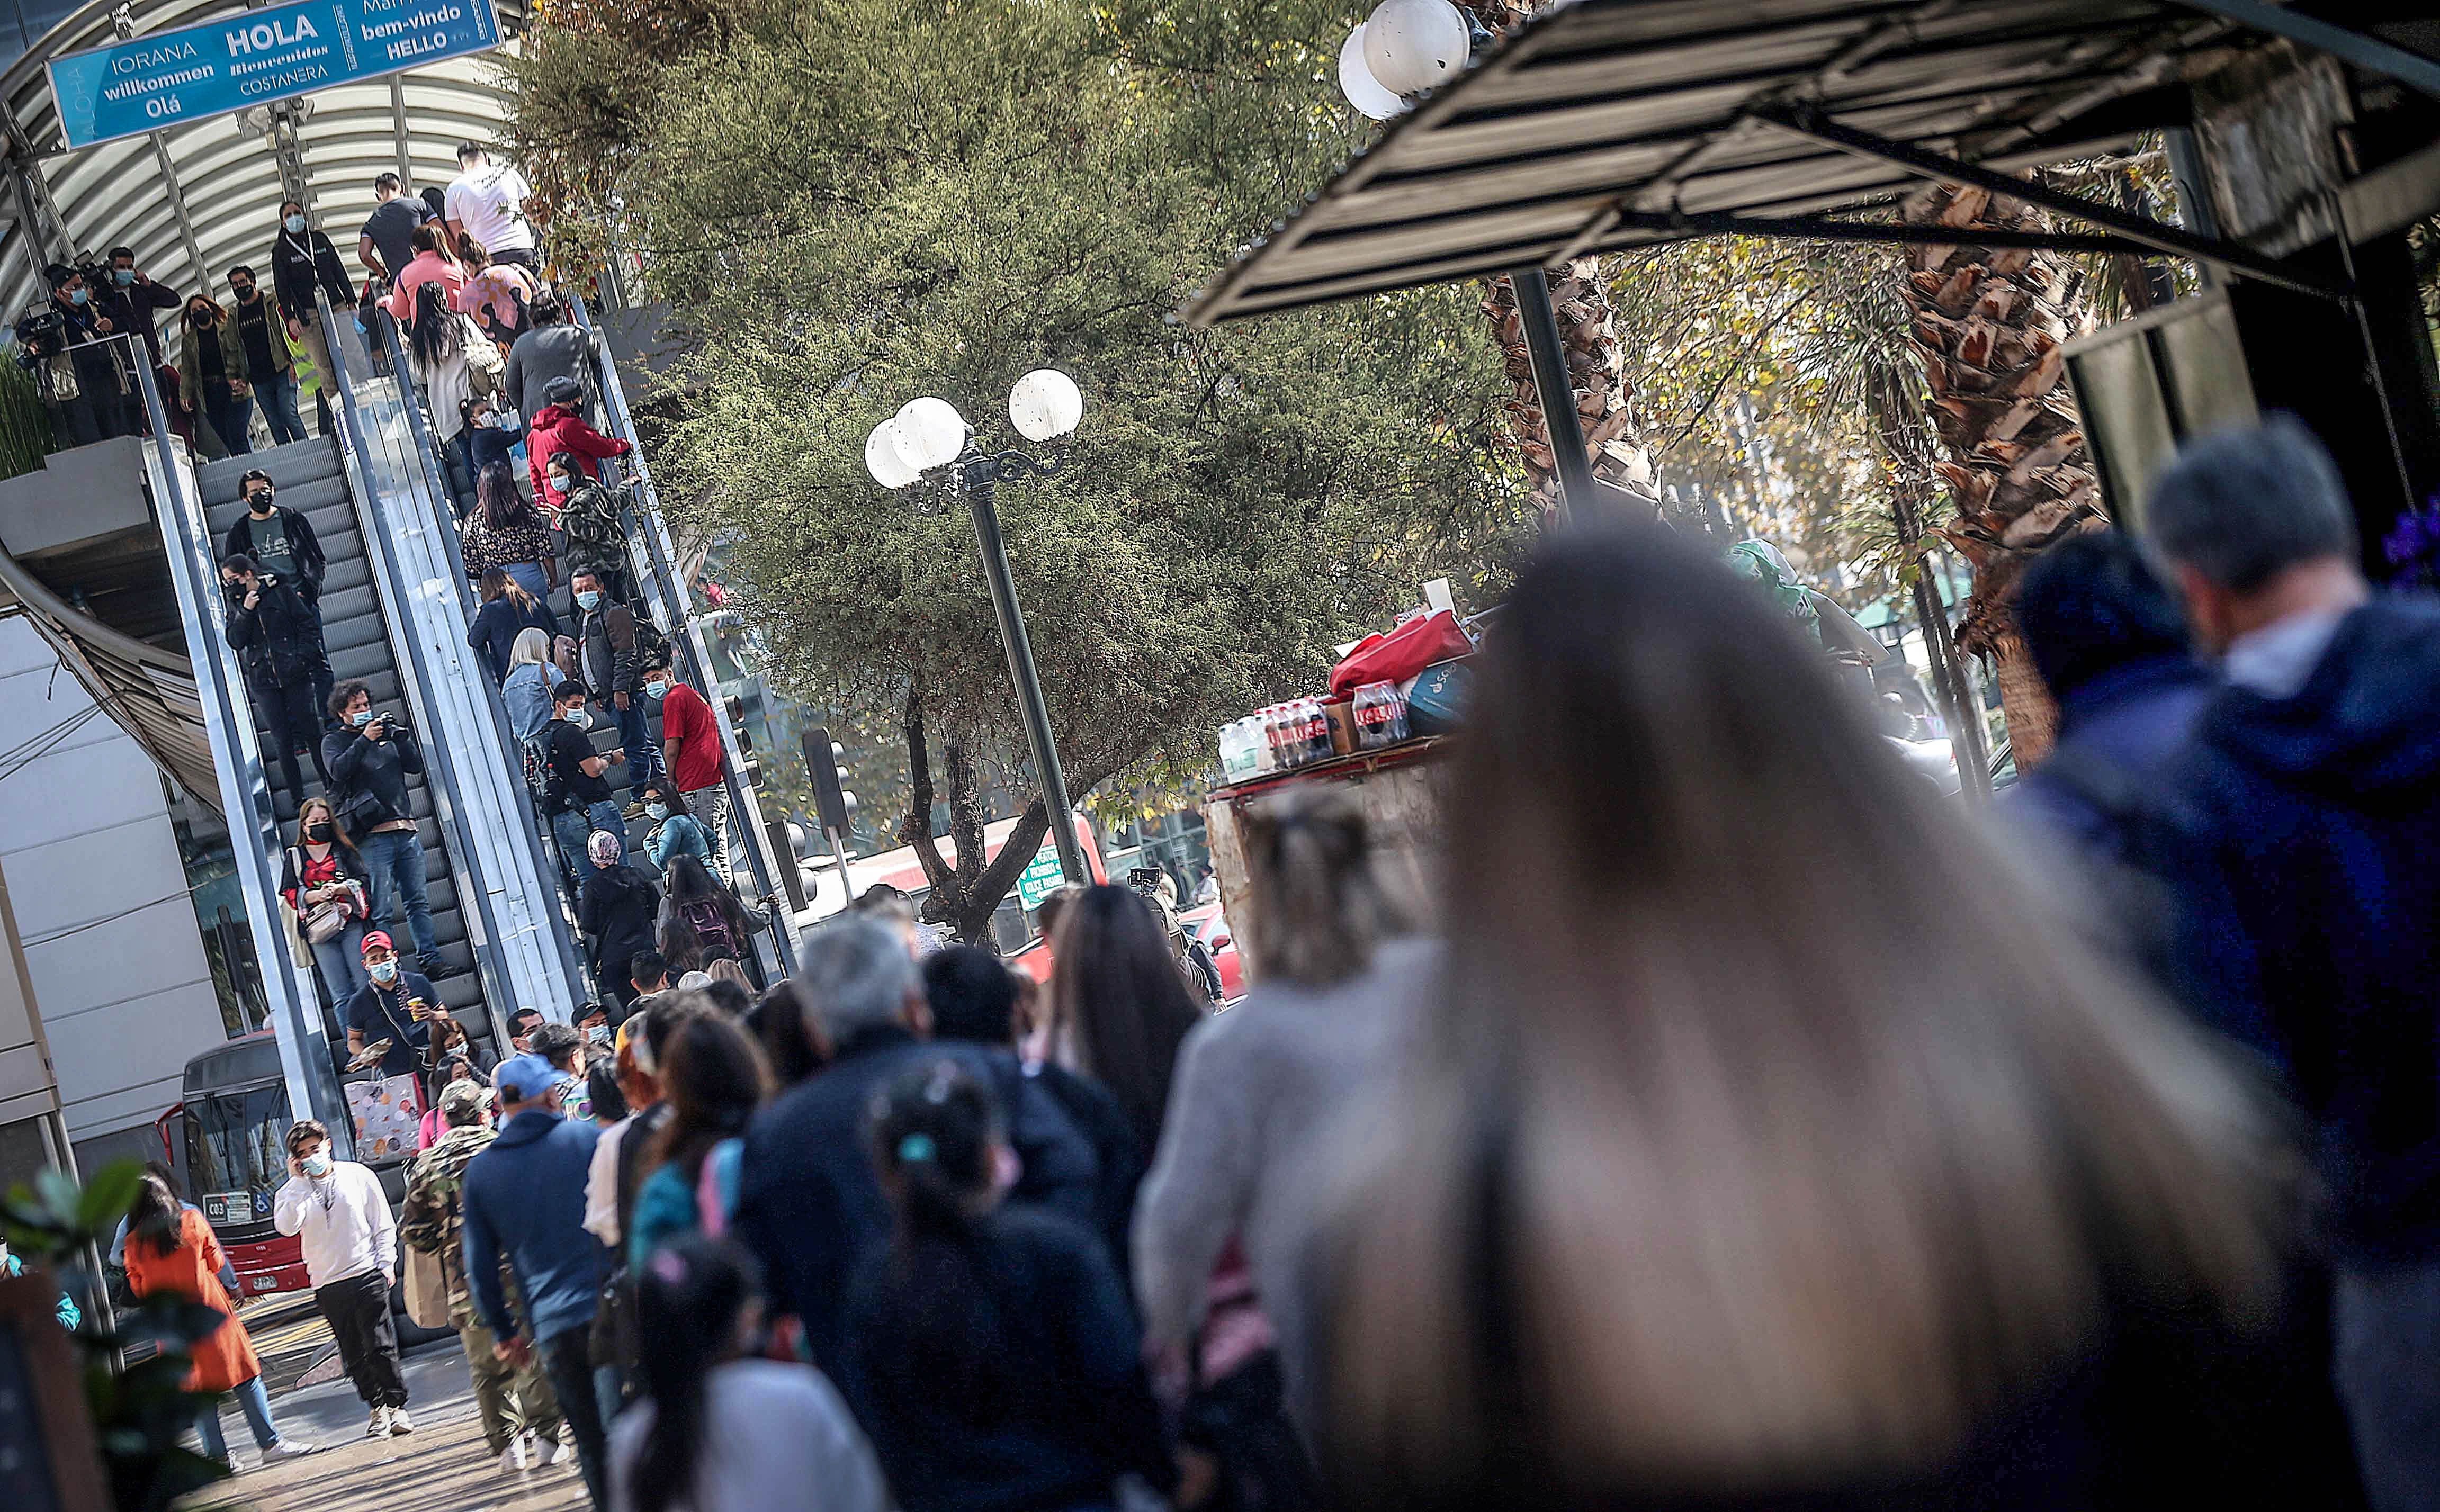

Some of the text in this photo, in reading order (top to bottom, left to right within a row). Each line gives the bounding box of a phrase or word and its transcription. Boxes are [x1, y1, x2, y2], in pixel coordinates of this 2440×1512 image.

[226, 14, 318, 58] HOLA
[361, 4, 461, 41] bem-vindo
[111, 42, 198, 75] IORANA
[386, 31, 447, 61] HELLO
[104, 64, 214, 102] willkommen
[240, 64, 329, 96] COSTANERA
[146, 93, 182, 118] Olá
